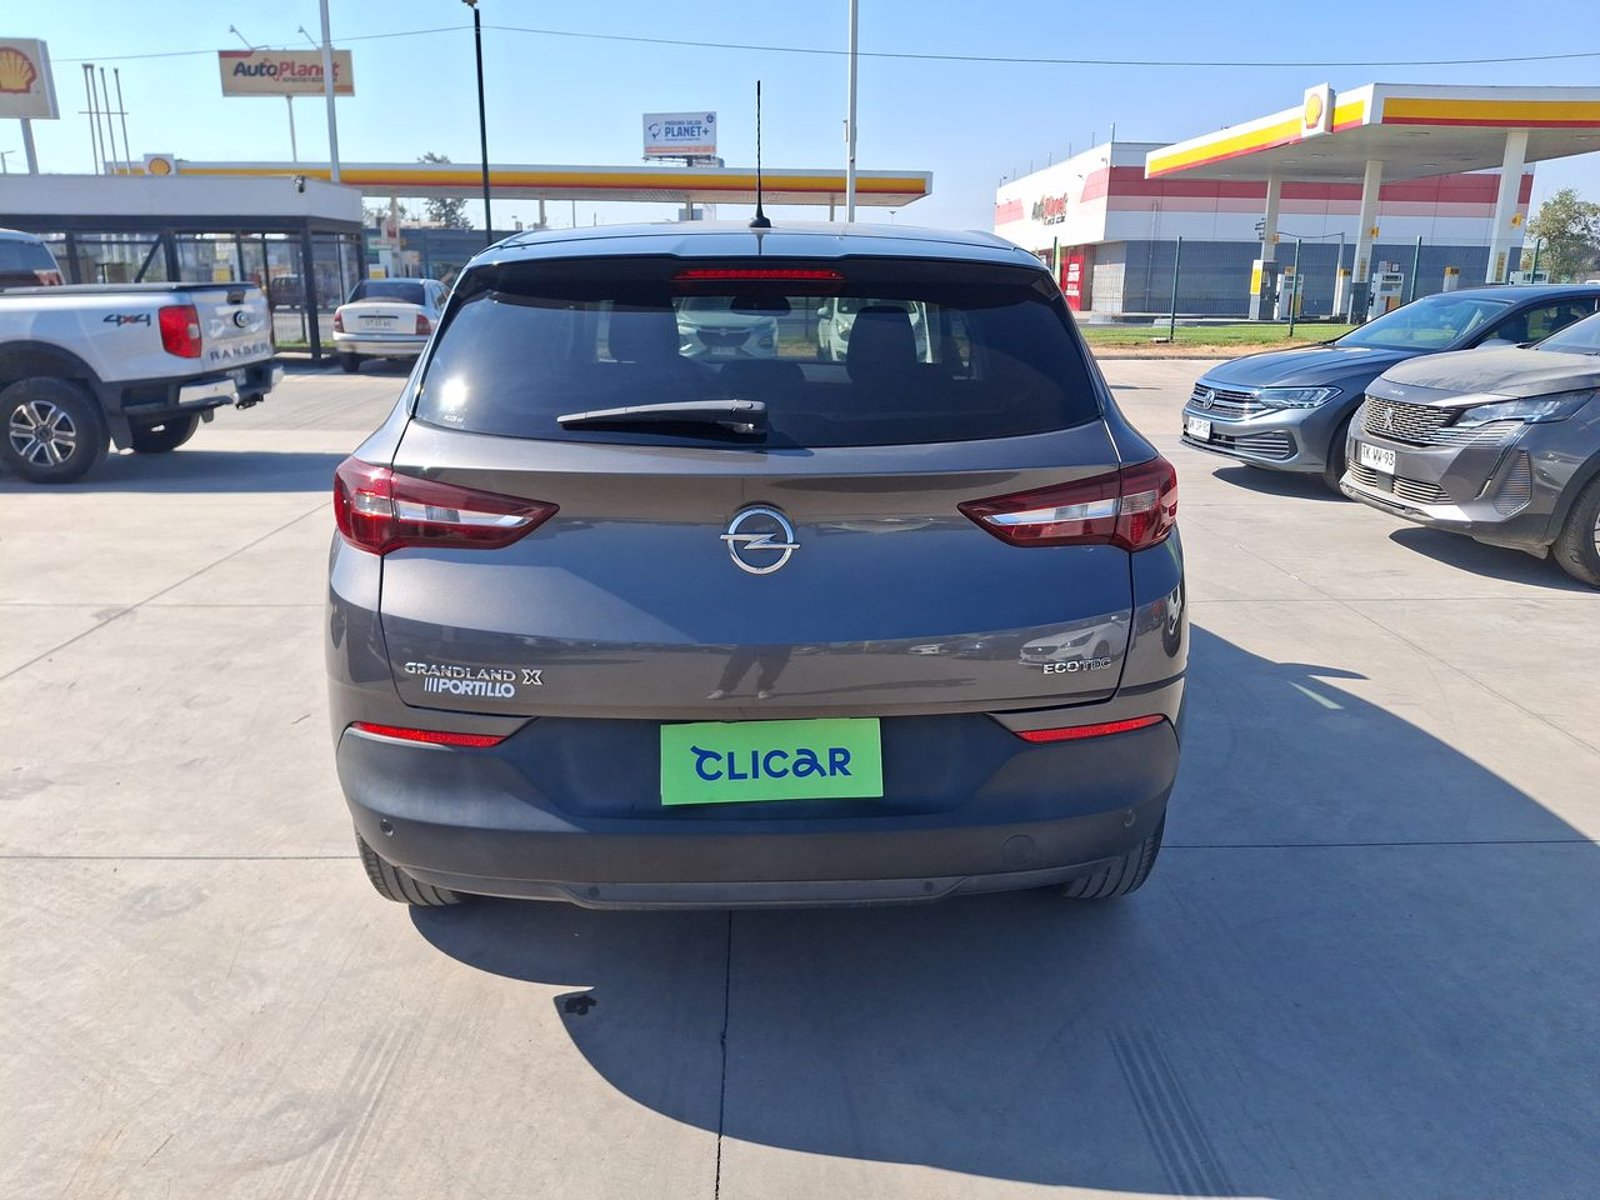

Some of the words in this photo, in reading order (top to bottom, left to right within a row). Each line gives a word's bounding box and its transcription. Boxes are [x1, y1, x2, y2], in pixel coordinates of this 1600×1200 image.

[233, 61, 340, 79] AutoPlant
[404, 661, 517, 682] GRANDLAND
[520, 668, 544, 686] X
[1043, 657, 1111, 675] ECOTEC
